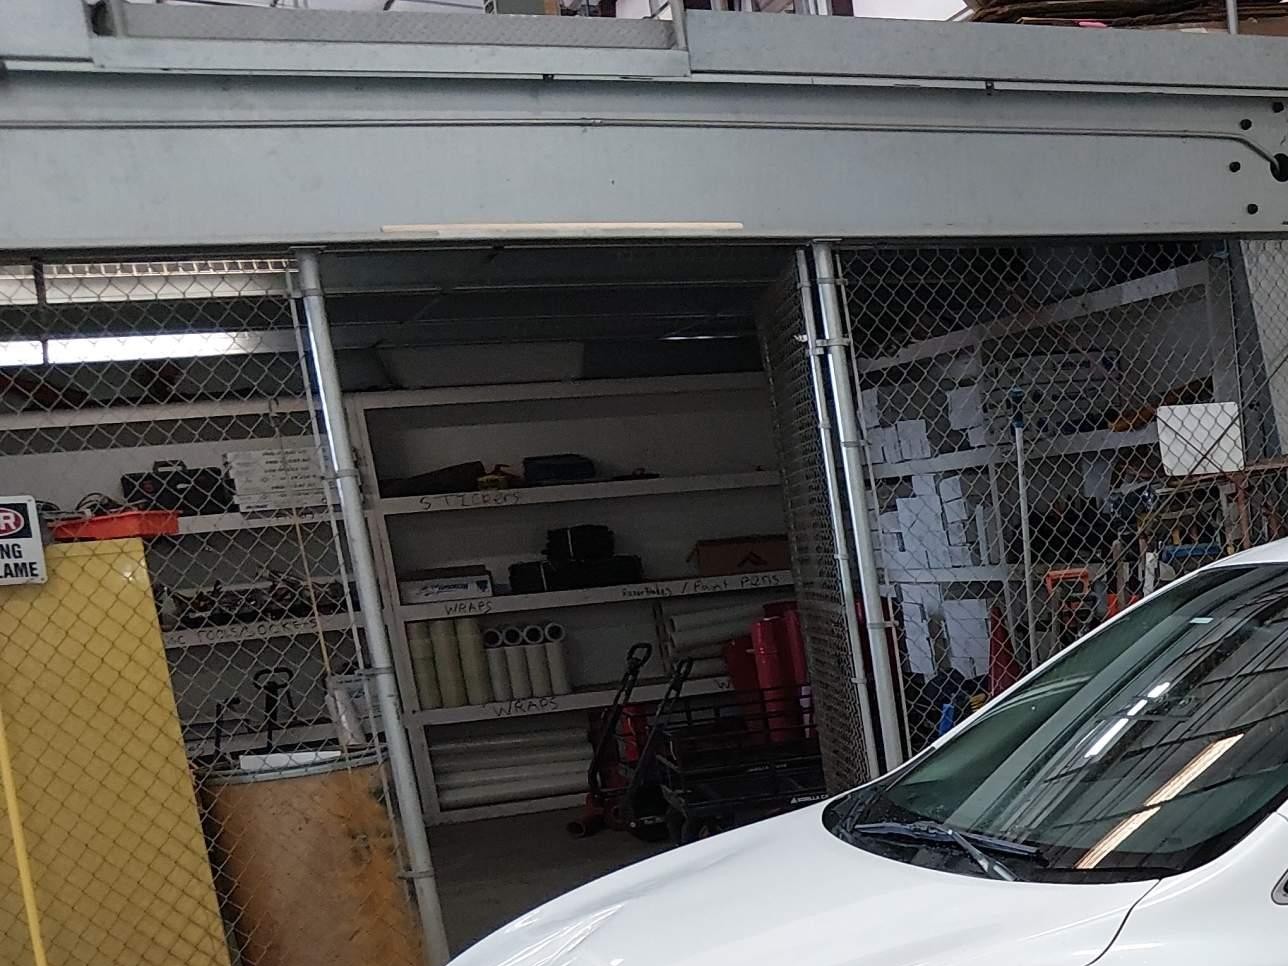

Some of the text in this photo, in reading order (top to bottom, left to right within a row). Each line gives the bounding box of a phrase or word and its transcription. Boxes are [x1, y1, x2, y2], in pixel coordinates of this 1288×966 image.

[0, 561, 39, 579] AME
[445, 601, 492, 614] WRAPS
[493, 697, 558, 717] WRAPS
